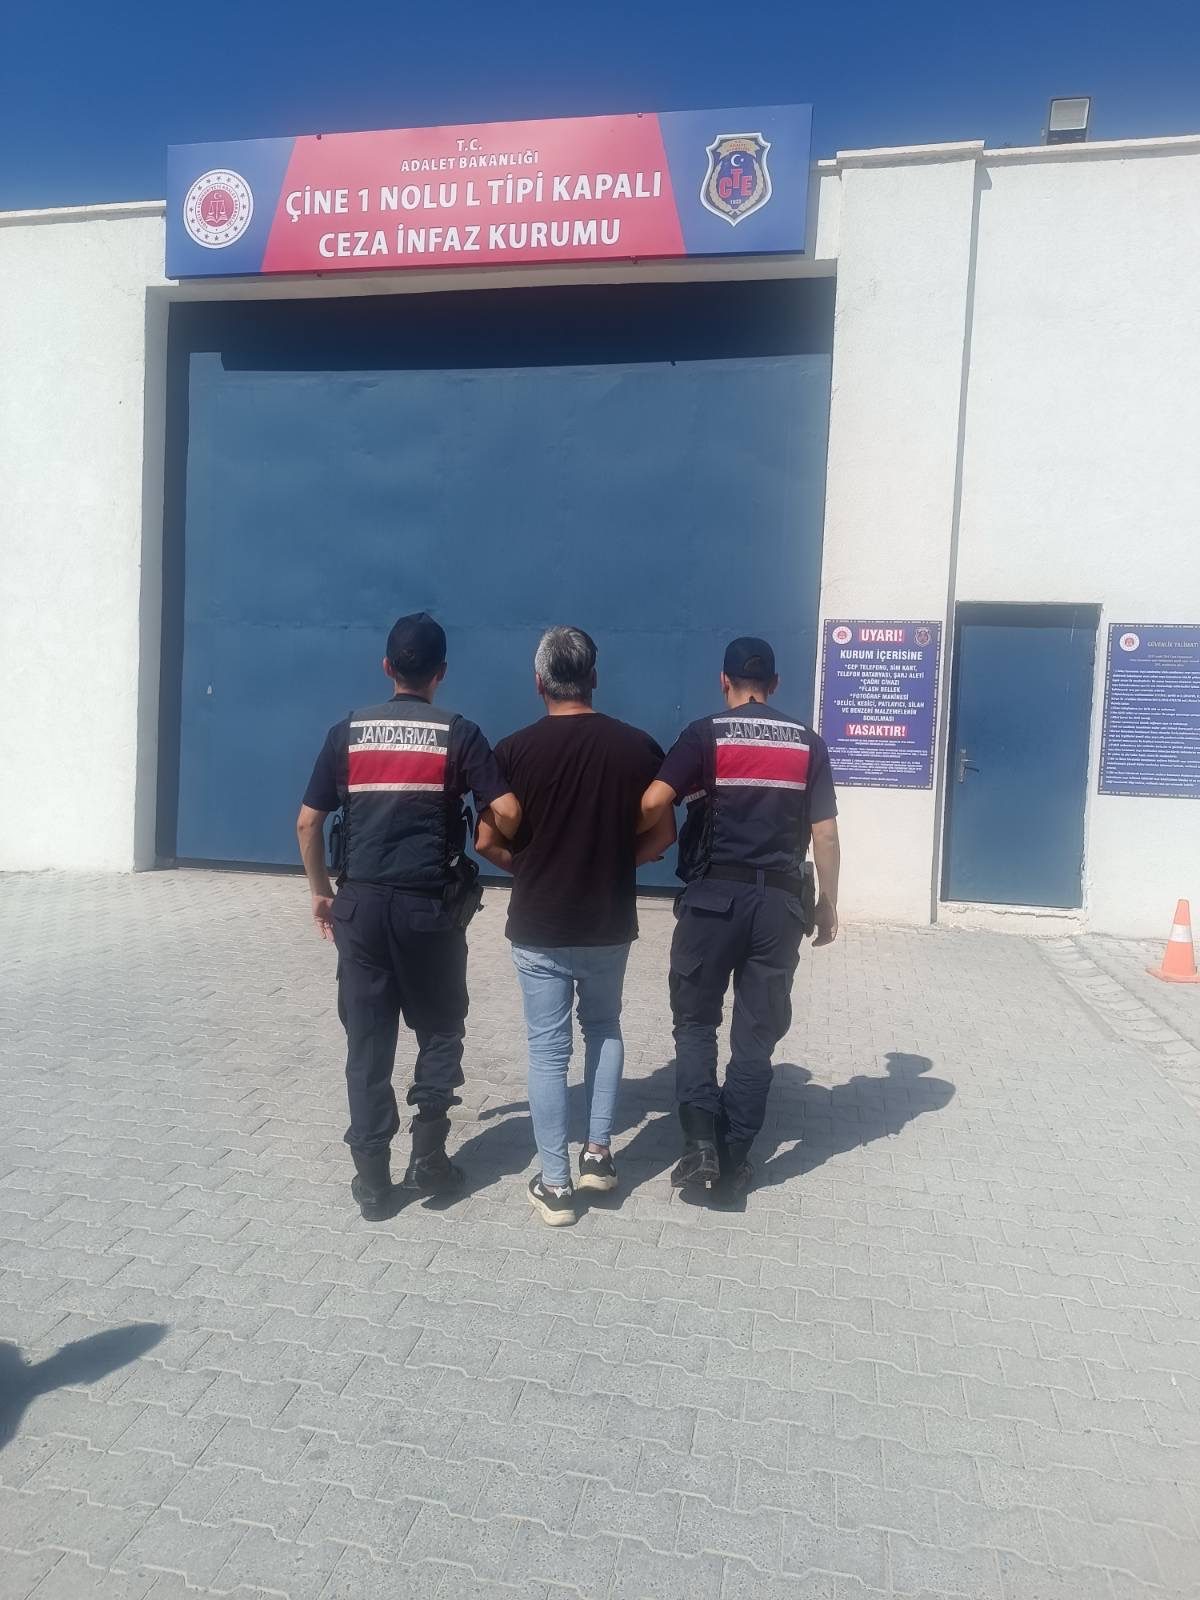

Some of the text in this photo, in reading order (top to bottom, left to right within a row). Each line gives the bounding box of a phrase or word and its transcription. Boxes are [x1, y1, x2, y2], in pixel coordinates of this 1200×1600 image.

[456, 138, 483, 151] T.C.
[401, 150, 539, 172] ADALET BAKANLIĞI
[719, 168, 752, 198] CTE
[285, 171, 662, 222] ÇİNE 1 NOLU L TİPİ KAPALI
[319, 219, 620, 258] CEZA İNFAZ KURUMU
[861, 629, 903, 642] UYARI!
[840, 649, 923, 663] KURUM İÇERİSİNE
[357, 726, 438, 746] JANDARMA
[725, 722, 802, 743] JANDARMA
[848, 724, 906, 737] YASAKTIR!
